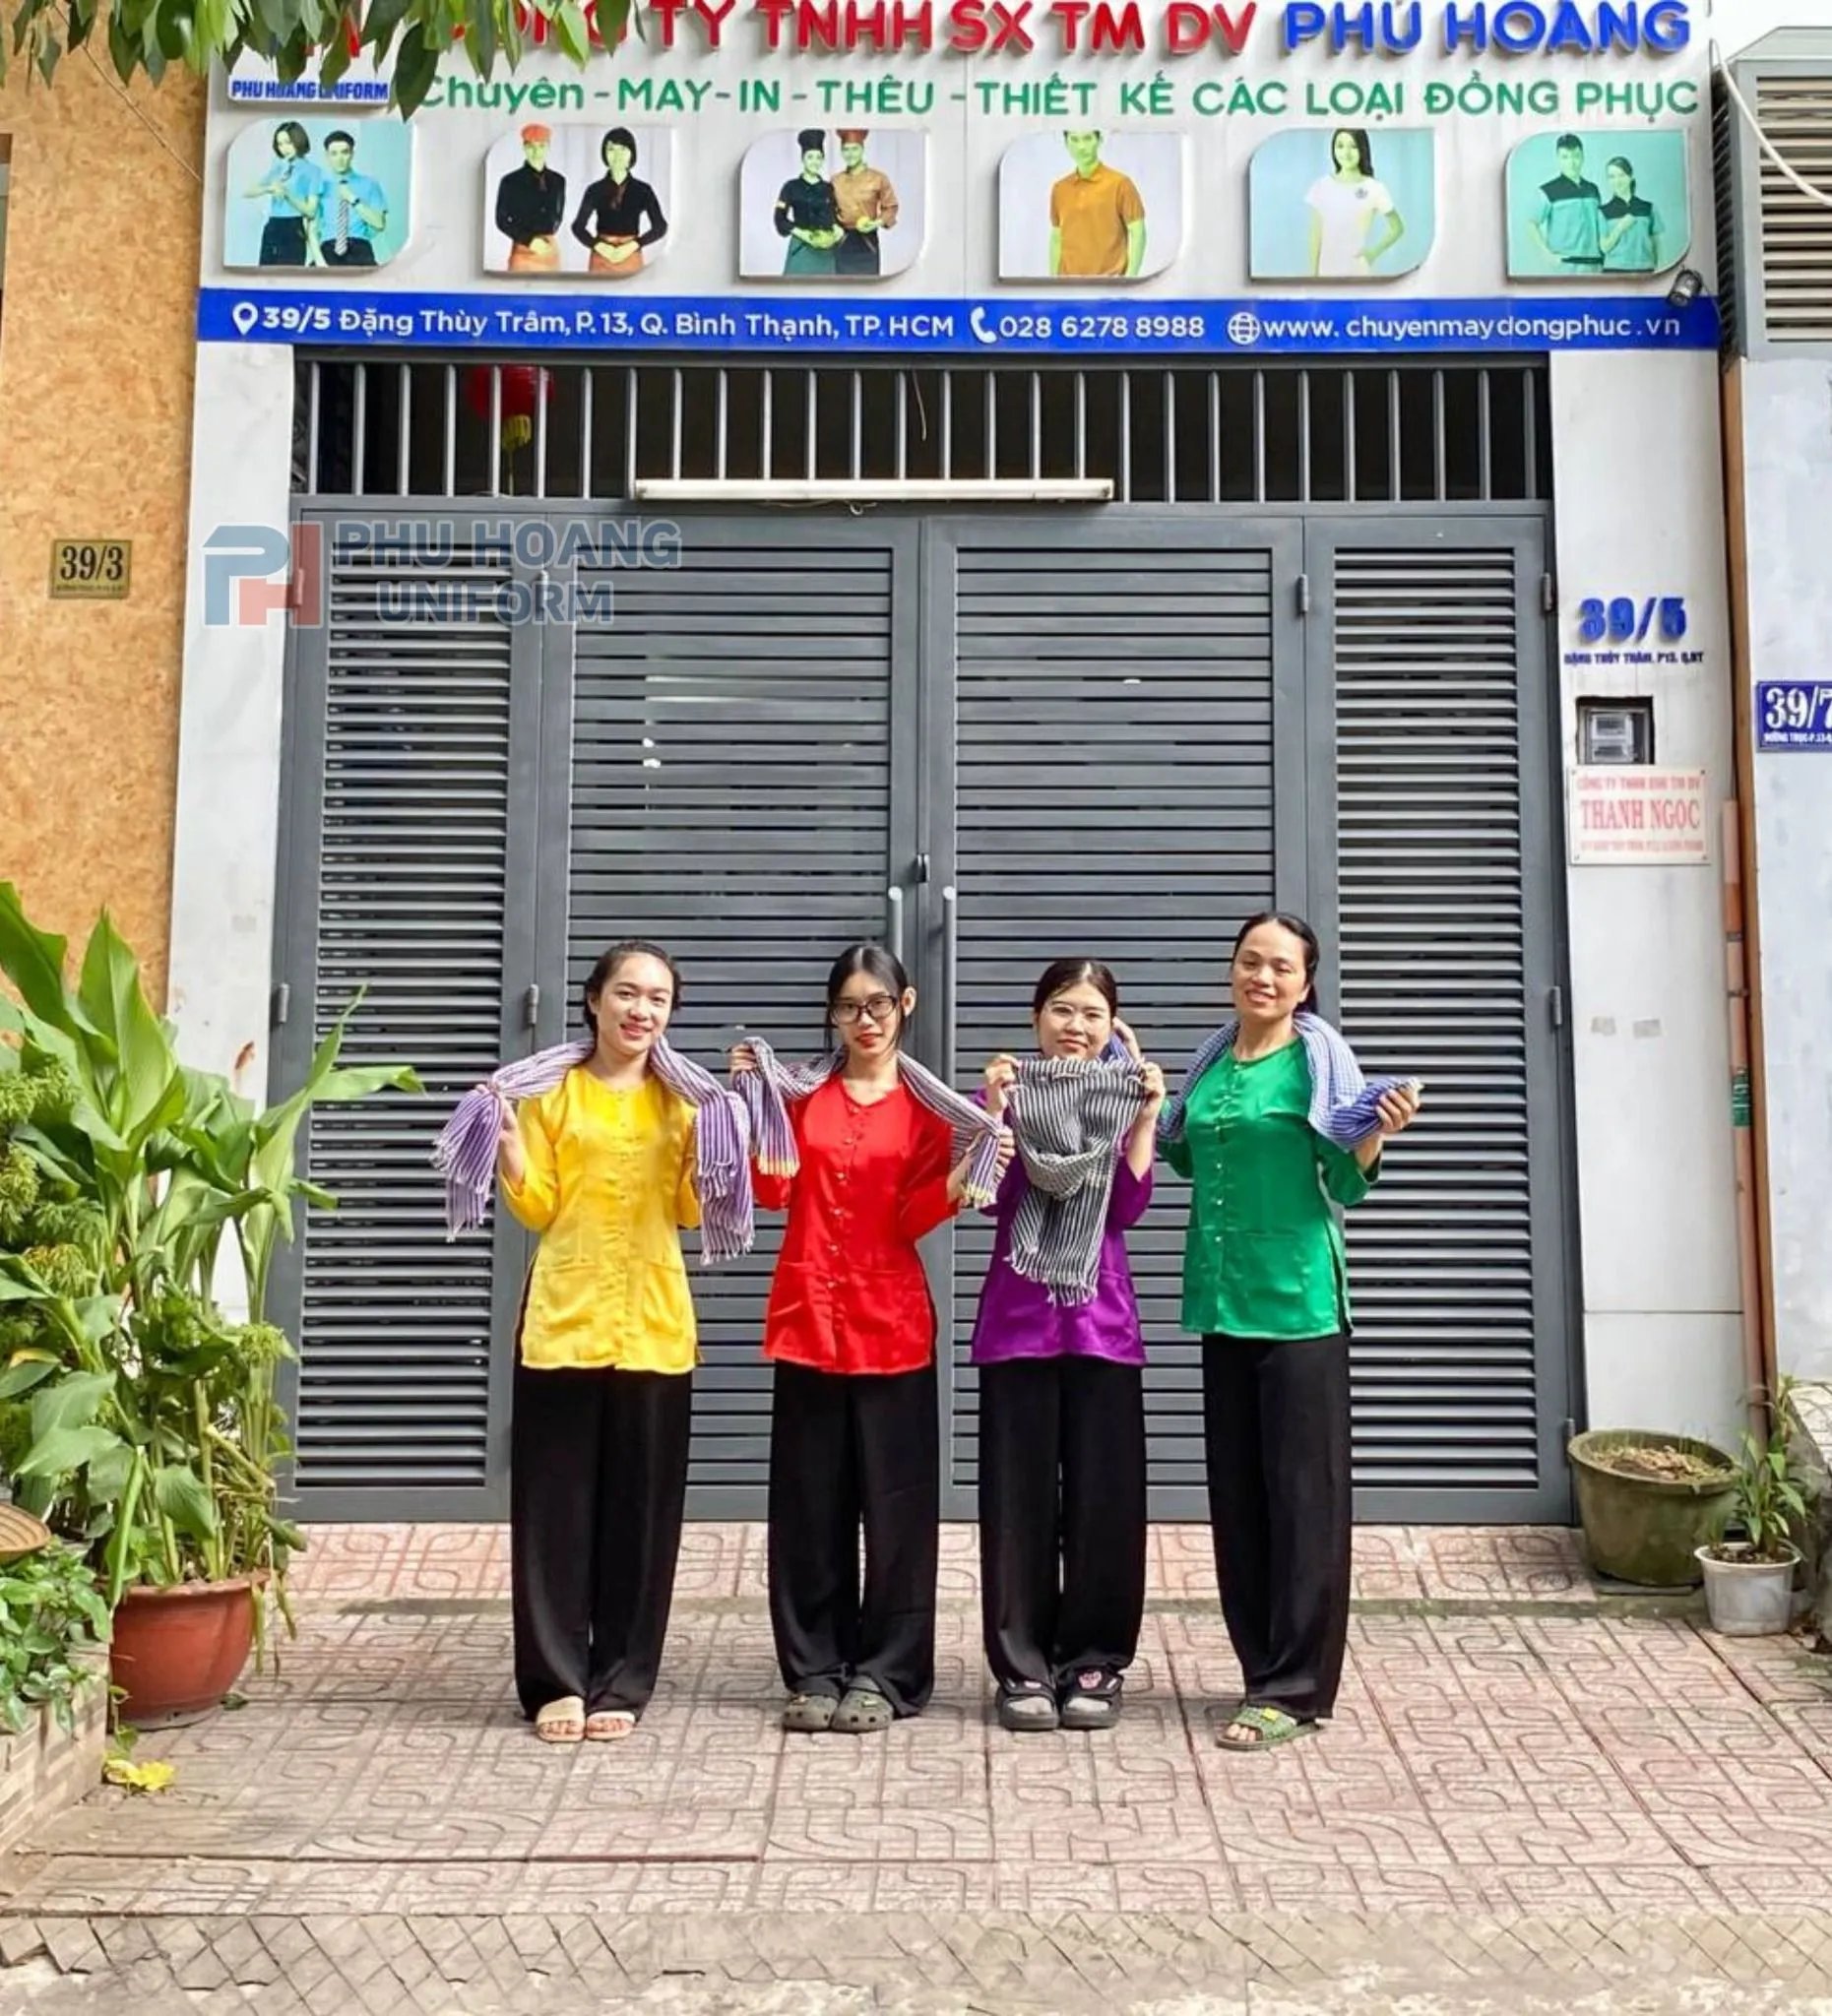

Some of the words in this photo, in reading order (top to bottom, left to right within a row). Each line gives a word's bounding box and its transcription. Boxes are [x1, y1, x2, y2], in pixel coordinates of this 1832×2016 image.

[650, 0, 735, 49] TY
[748, 0, 933, 51] TNHH
[949, 0, 1034, 51] SX
[1049, 1, 1145, 52] TM
[1165, 2, 1257, 55] DV
[231, 80, 264, 97] PHU
[618, 78, 712, 111] MAY
[740, 81, 781, 111] IN
[816, 74, 934, 113] THÊU
[974, 72, 1098, 115] THIẾT
[1120, 70, 1174, 115] KẾ
[1192, 76, 1288, 116] CÁC
[1306, 82, 1404, 121] LOẠI
[1423, 70, 1558, 115] ĐỒNG
[1577, 82, 1699, 123] PHỤC
[263, 307, 332, 333] 39/5
[340, 309, 413, 337] Đặng
[419, 309, 488, 336] Thùy
[495, 309, 571, 336] Trâm,
[640, 313, 668, 336] Q.
[675, 312, 736, 336] Bình
[745, 314, 840, 342] Thạnh,
[998, 316, 1052, 339] 028
[1060, 316, 1129, 339] 6278
[1135, 316, 1205, 339] 8988
[60, 545, 123, 581] 39/3
[1579, 597, 1686, 642] 39/5
[1580, 799, 1644, 830] THANH
